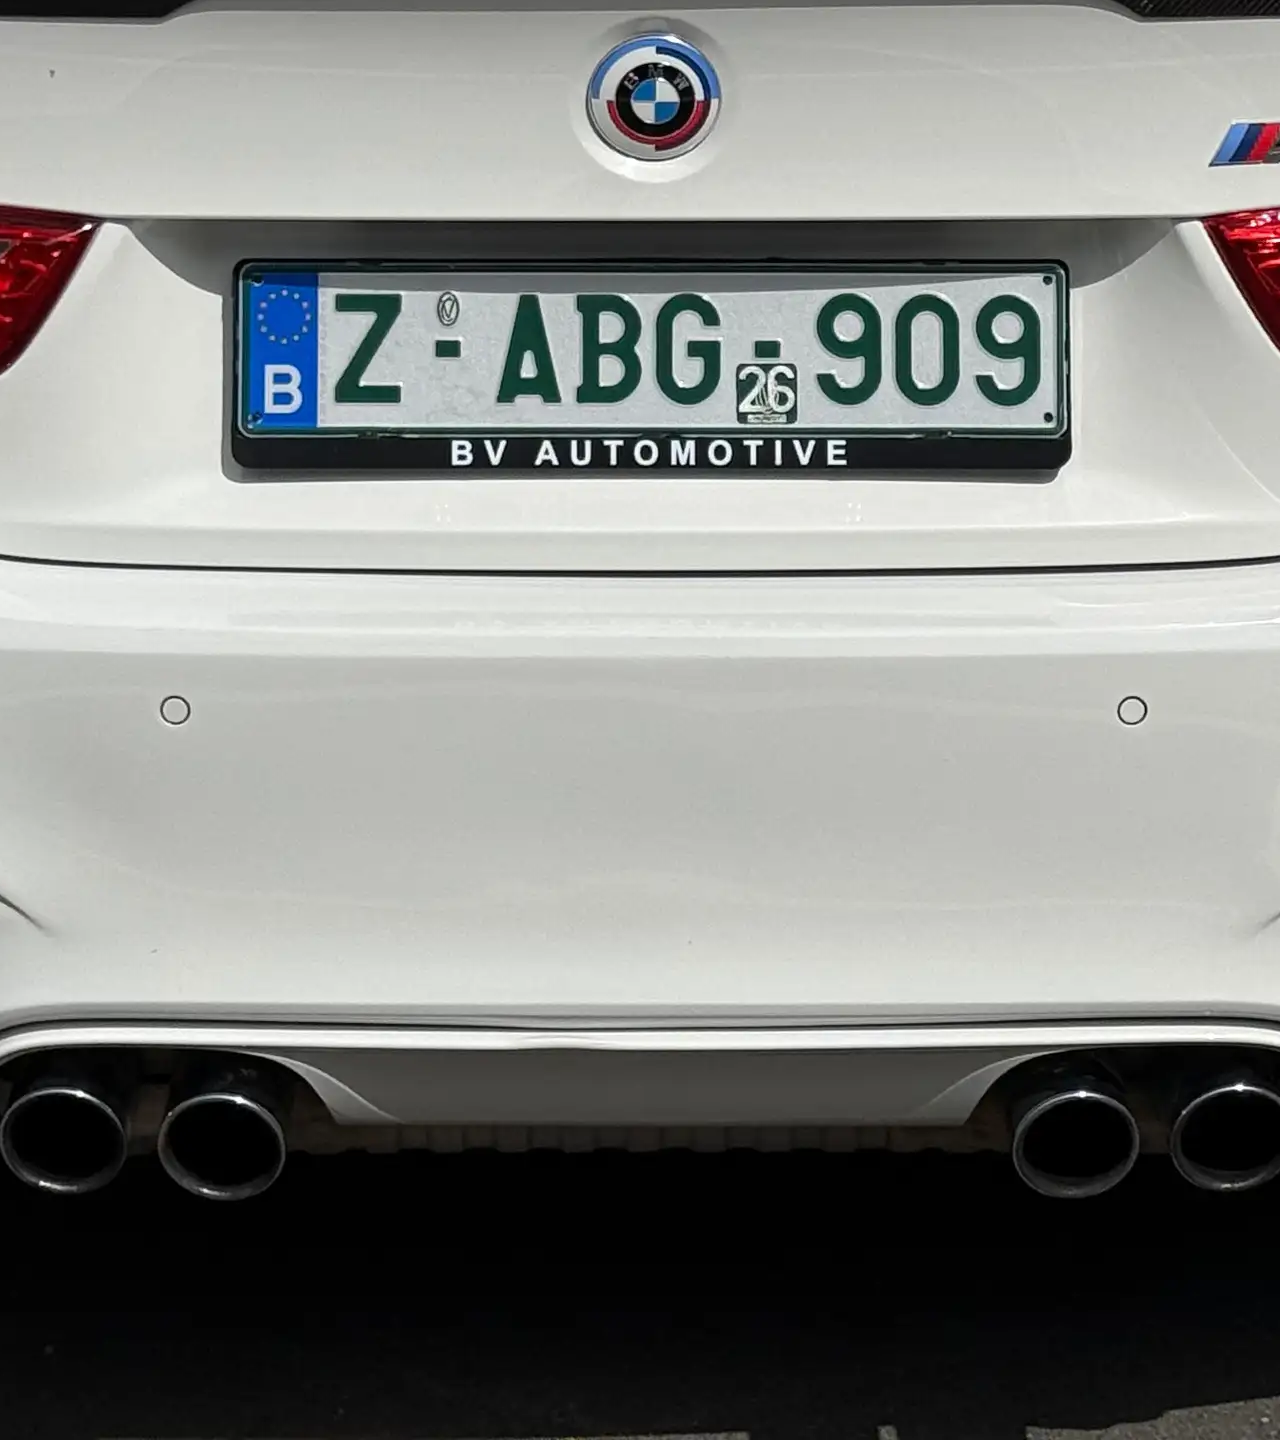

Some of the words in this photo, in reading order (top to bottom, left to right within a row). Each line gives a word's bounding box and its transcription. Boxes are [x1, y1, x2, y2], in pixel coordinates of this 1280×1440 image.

[624, 64, 690, 91] BMW
[263, 364, 303, 414] B
[738, 364, 796, 414] 26
[451, 439, 508, 467] BV
[534, 438, 849, 467] AUTOMOTIVE
